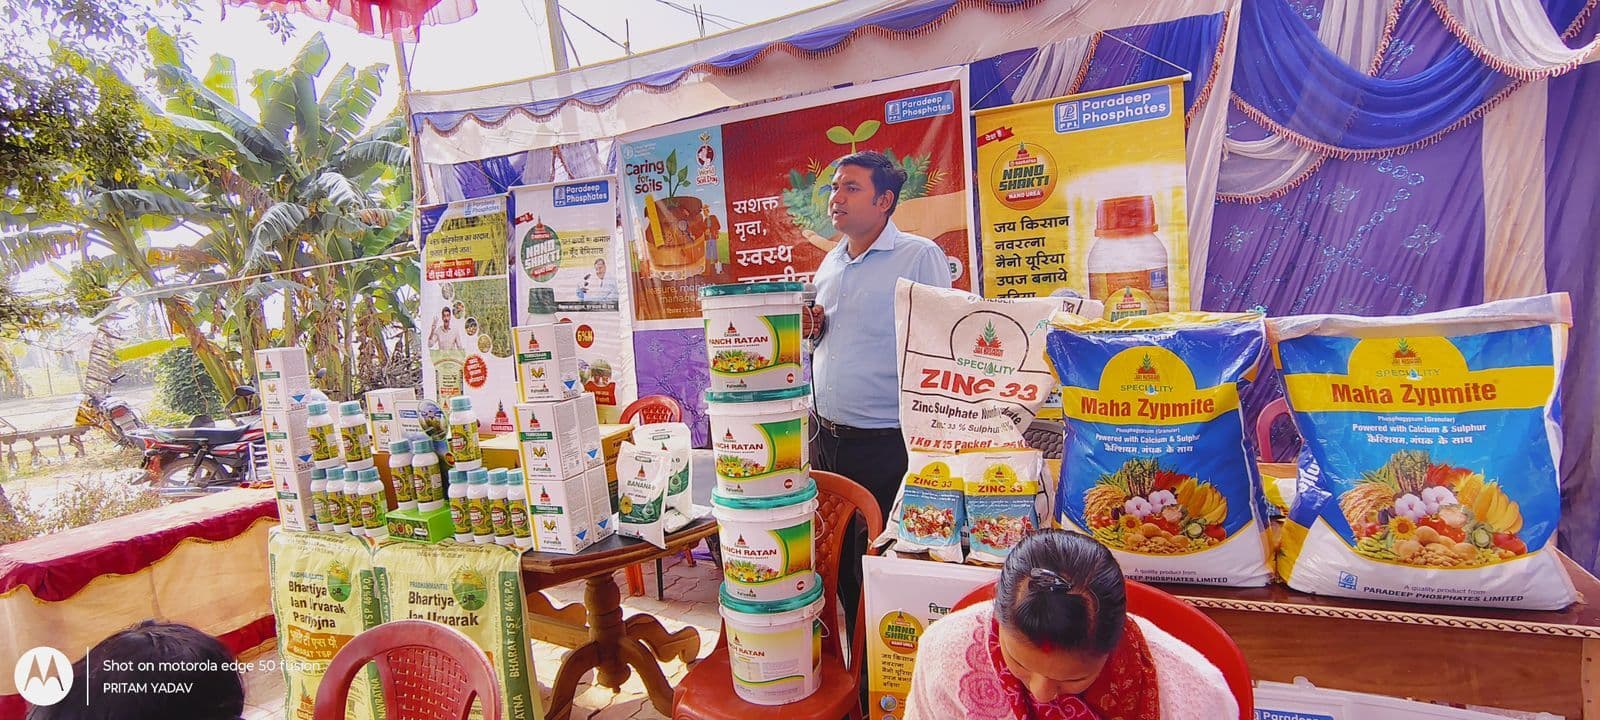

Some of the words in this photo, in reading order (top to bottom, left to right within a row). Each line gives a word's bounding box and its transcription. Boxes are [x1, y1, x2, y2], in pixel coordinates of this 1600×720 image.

[902, 96, 943, 109] Paradeep
[1082, 93, 1152, 111] Paradeep
[902, 104, 951, 117] Phosphates
[1083, 103, 1166, 123] Phosphates
[625, 160, 664, 176] Caring
[1003, 165, 1044, 180] NANO
[635, 179, 663, 194] soils
[638, 174, 648, 183] for
[999, 176, 1049, 191] SHAKTI
[566, 184, 600, 194] Paradeep
[566, 192, 607, 204] Phosphates
[733, 196, 780, 213] सशक्त
[734, 220, 767, 241] मृदा,
[994, 221, 1017, 232] जय
[1020, 216, 1070, 231] किसान
[995, 237, 1046, 251] नवरत्ना
[524, 251, 560, 270] SHAKTI
[736, 245, 793, 266] स्वस्थ
[995, 253, 1022, 268] नैनो
[1025, 250, 1066, 271] यूरिया
[996, 274, 1027, 286] उपज
[1031, 268, 1068, 283] बनाये
[734, 336, 768, 344] RATAN
[920, 368, 996, 396] ZINC
[999, 382, 1038, 401] 33
[1331, 383, 1393, 404] Maha
[1400, 382, 1497, 407] Zypmite
[911, 399, 934, 414] Zinc
[934, 402, 979, 420] Sulphate
[1081, 396, 1131, 417] Maha
[1138, 398, 1215, 420] Zypmite
[1352, 424, 1388, 432] Powered
[1390, 424, 1407, 433] with
[1409, 425, 1440, 434] Calcium
[1451, 423, 1487, 433] Sulphur
[909, 436, 915, 445] 1
[954, 439, 992, 449] Packet
[1095, 433, 1122, 442] Powered
[1124, 434, 1139, 443] with
[1140, 435, 1167, 443] Calcium
[1438, 434, 1448, 445] के
[1452, 436, 1473, 445] साथ
[627, 480, 653, 490] BANANA
[914, 476, 939, 487] ZINC
[941, 480, 953, 488] 33
[977, 485, 1006, 493] ZINC
[1009, 485, 1023, 493] 33
[288, 580, 328, 598] Bhartiya
[1363, 586, 1414, 598] PARADEEP
[1416, 593, 1480, 602] PHOSPHATES
[1483, 594, 1524, 603] LIMITED
[1411, 585, 1436, 593] quality
[1437, 587, 1466, 595] product
[408, 591, 454, 610] Bhartiya
[504, 594, 514, 611] 46%
[364, 608, 374, 626] TSP
[506, 615, 516, 635] TSP
[888, 624, 915, 634] NANO
[508, 639, 520, 678] BHARAT
[740, 649, 765, 657] RATAN
[512, 693, 525, 720] ATNA
